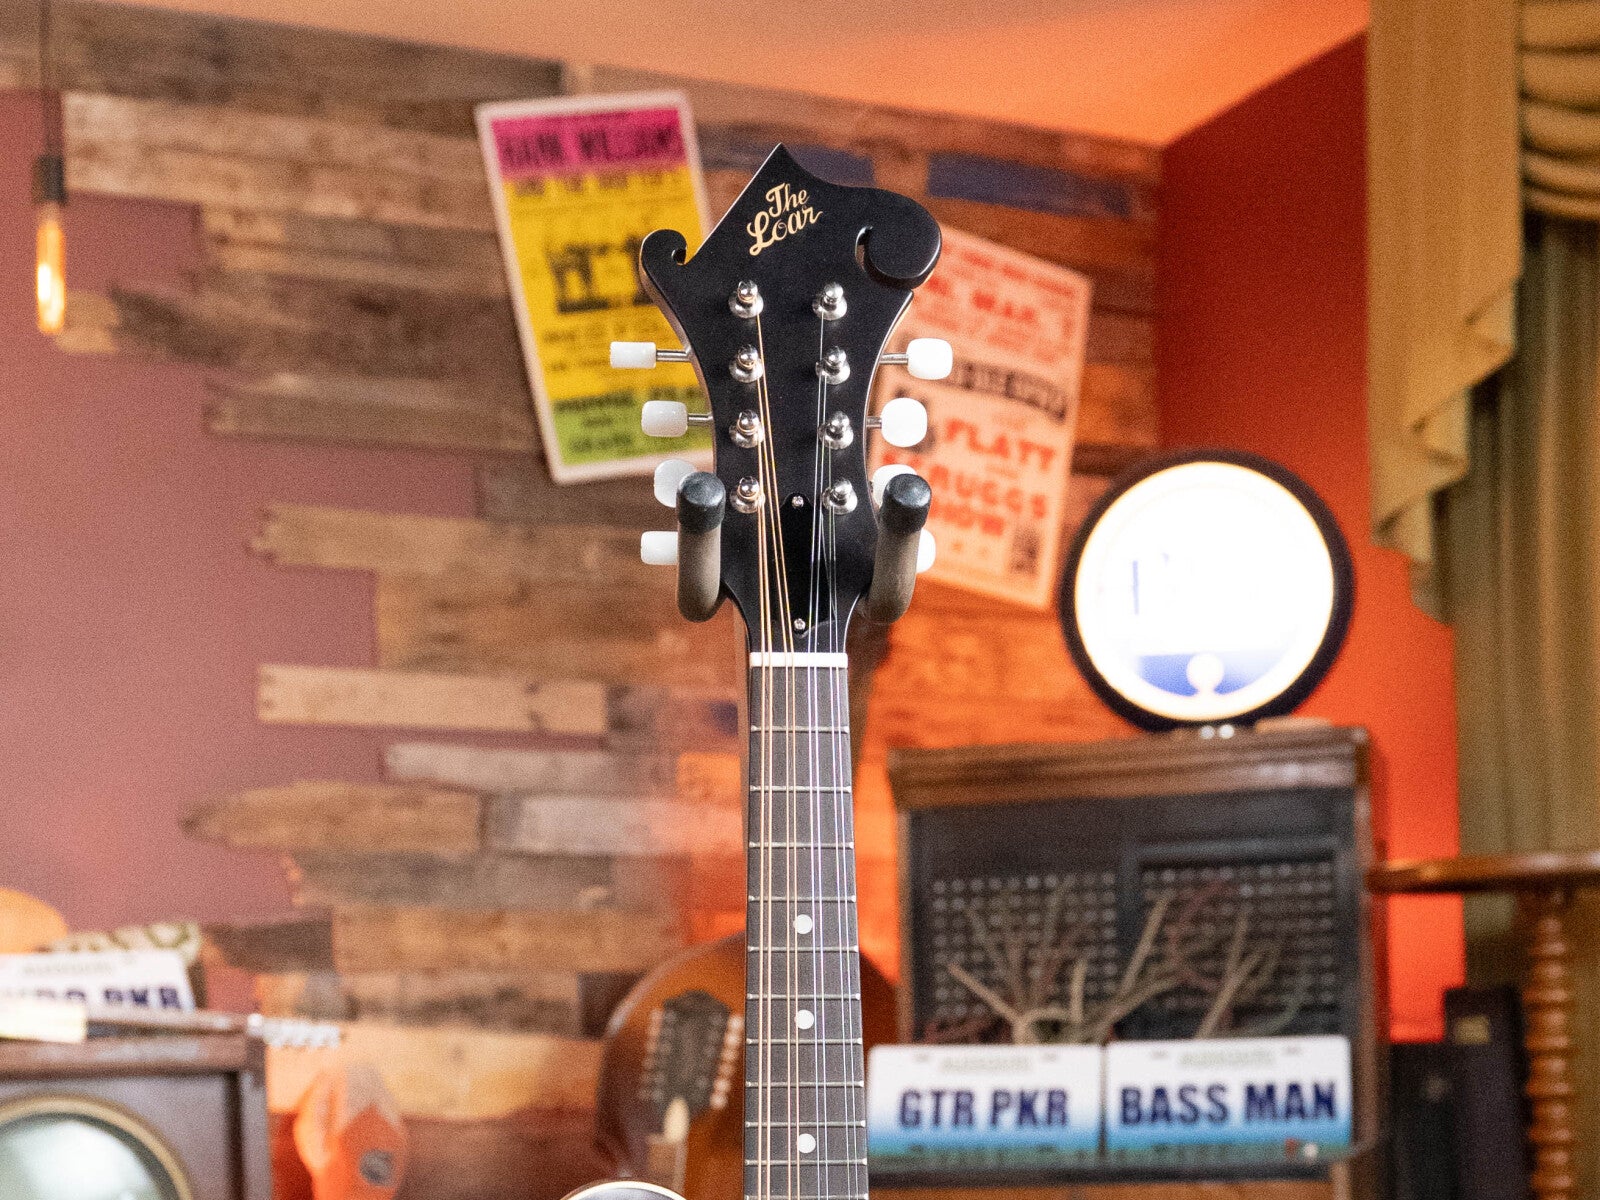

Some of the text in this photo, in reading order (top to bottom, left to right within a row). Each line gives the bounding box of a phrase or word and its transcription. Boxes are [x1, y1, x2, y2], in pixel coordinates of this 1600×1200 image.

[765, 182, 810, 218] The
[746, 204, 824, 256] Loar
[944, 419, 1056, 471] FLATT
[898, 1086, 1069, 1130] GTR PKR
[1119, 1080, 1337, 1127] BASS MAN
